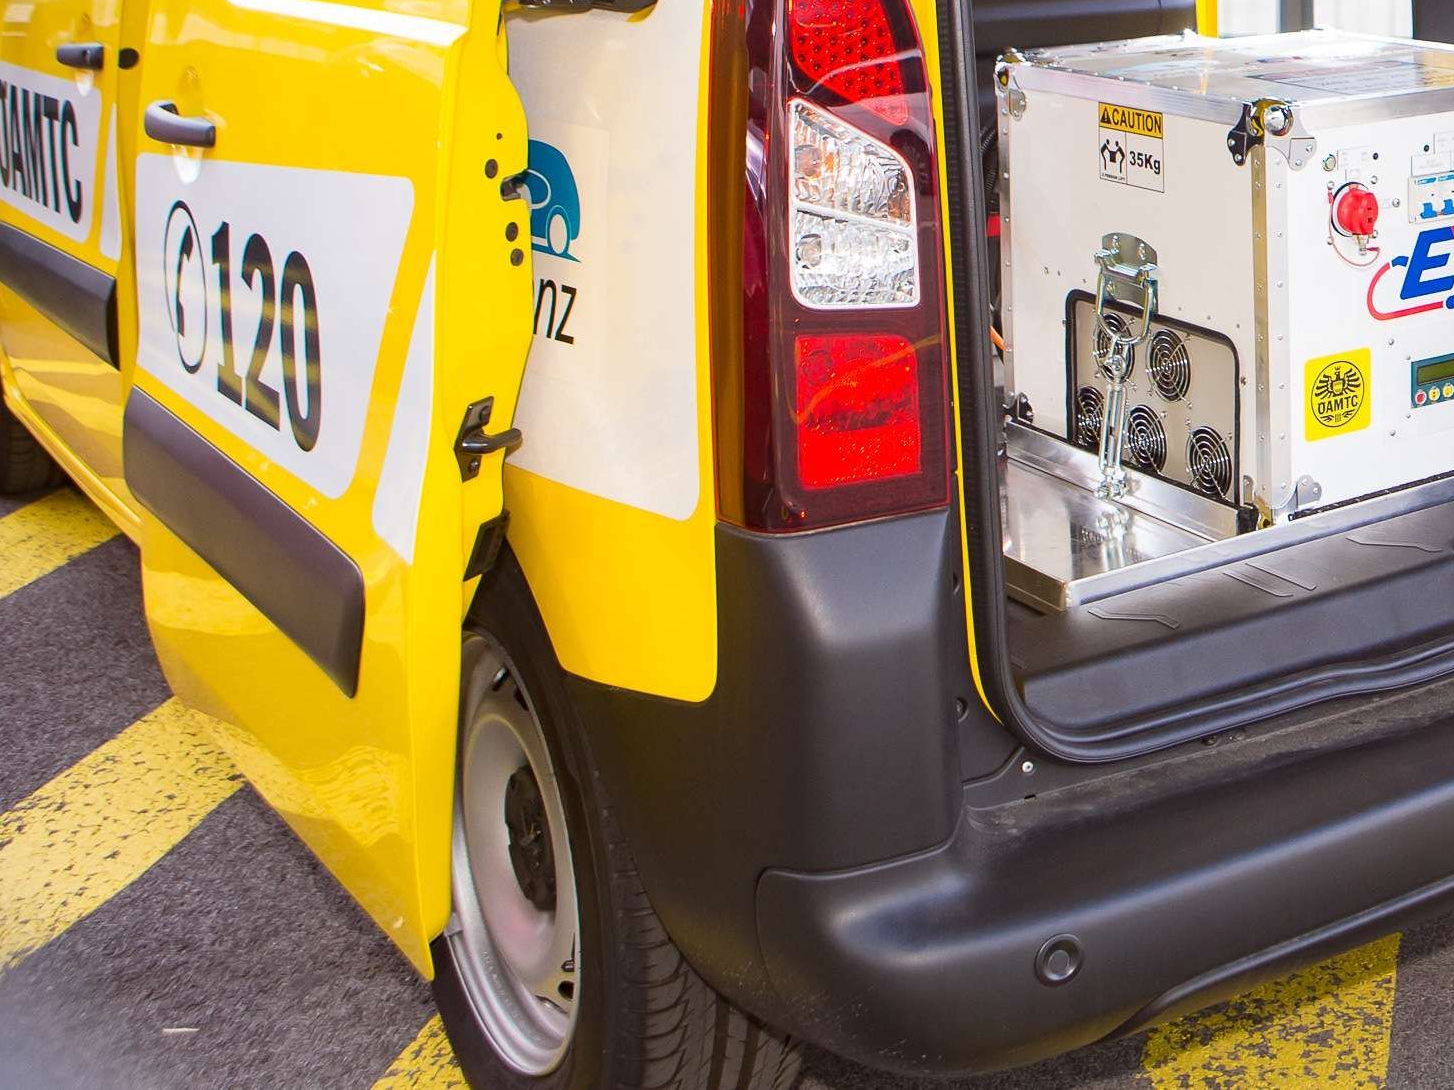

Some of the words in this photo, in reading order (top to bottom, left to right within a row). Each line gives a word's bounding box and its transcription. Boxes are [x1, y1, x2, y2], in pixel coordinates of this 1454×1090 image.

[1112, 108, 1162, 134] CAUTION
[1129, 150, 1161, 175] 35Kg
[211, 221, 322, 452] 120
